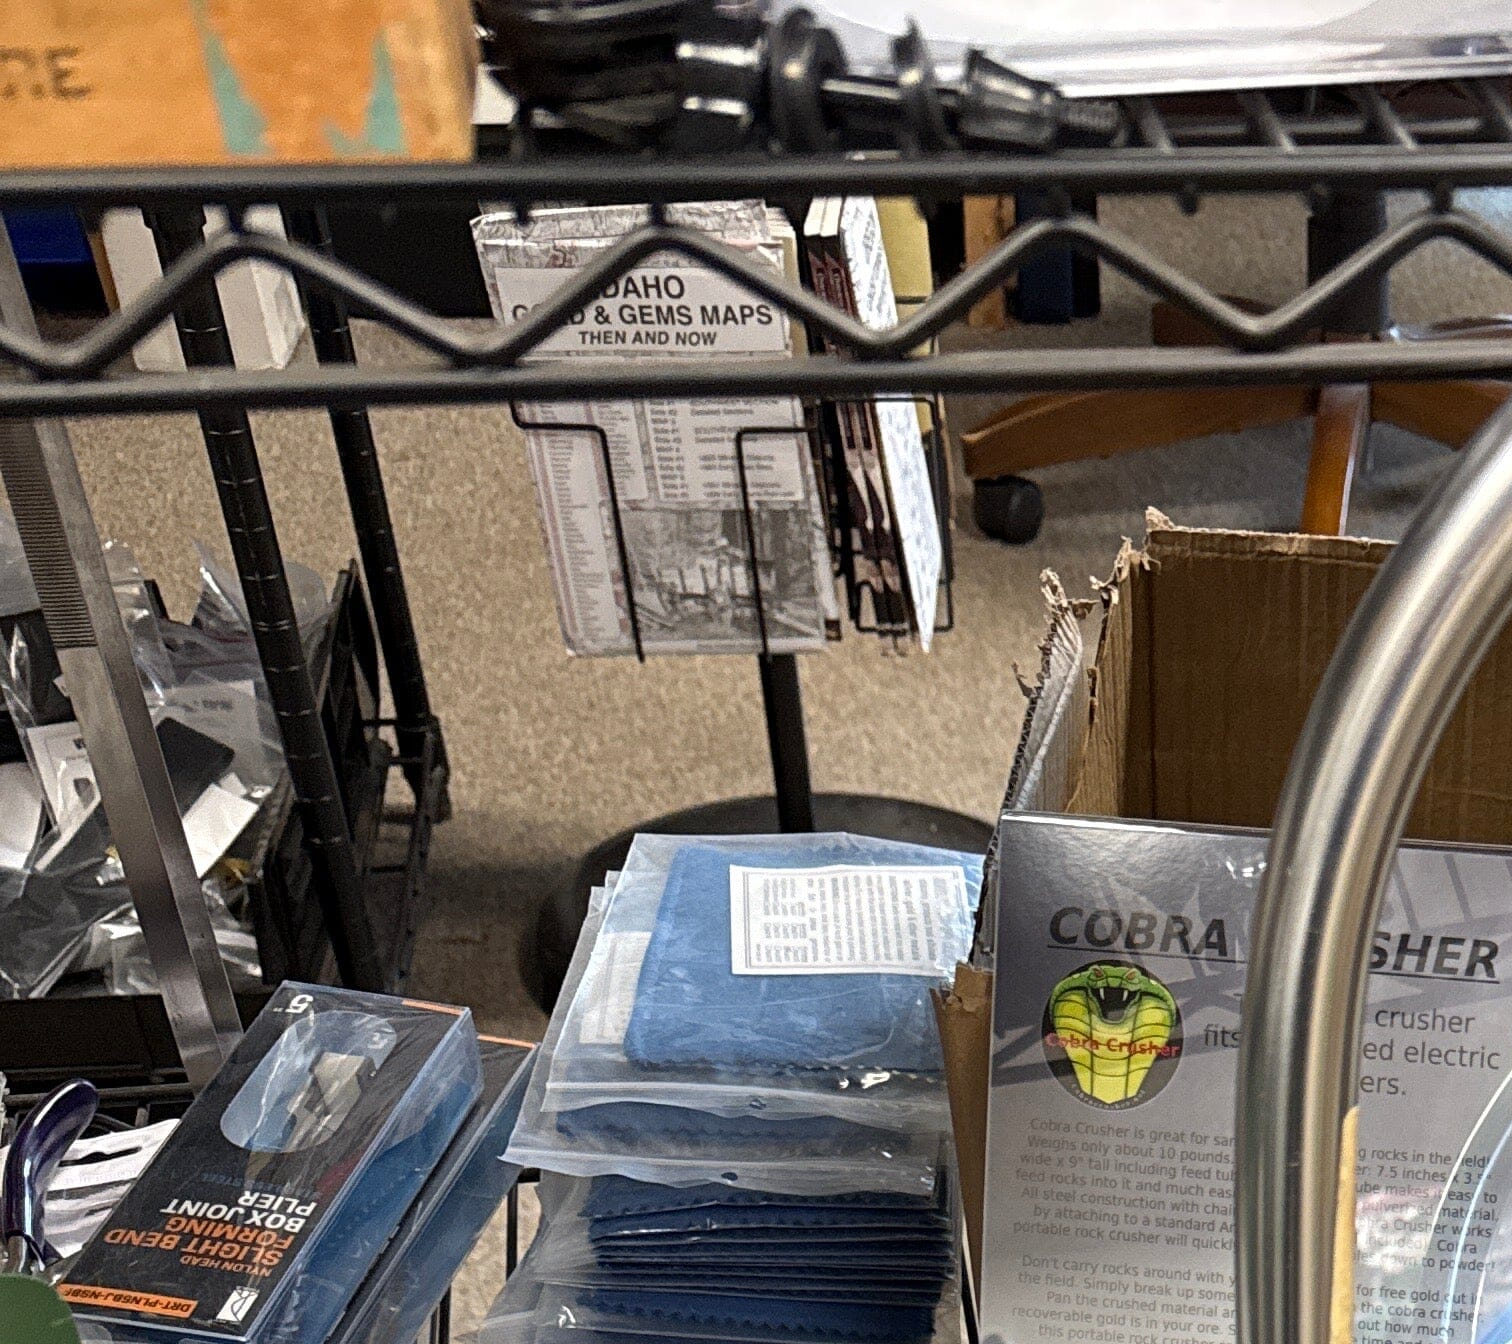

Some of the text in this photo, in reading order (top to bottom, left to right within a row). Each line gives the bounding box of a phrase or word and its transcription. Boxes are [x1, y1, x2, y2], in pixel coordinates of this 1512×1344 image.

[601, 275, 684, 299] DAHO
[595, 306, 611, 324] &
[619, 304, 692, 326] GEMS
[700, 304, 773, 325] MAPS
[579, 331, 717, 345] THEN AND NOW
[1049, 906, 1499, 979] COBRA SHER
[1374, 1008, 1475, 1033] crusher
[1107, 1038, 1180, 1057] Crusher
[1404, 1042, 1500, 1070] electric
[1075, 1121, 1130, 1138] Crusher
[1133, 1124, 1145, 1139] is
[1150, 1128, 1186, 1143] great
[1190, 1130, 1210, 1145] for
[1371, 1149, 1408, 1162] rocks
[1412, 1151, 1425, 1162] in
[1429, 1152, 1452, 1165] the
[160, 1199, 306, 1233] BOX JOINT
[238, 1190, 317, 1217] PLIER
[165, 1216, 295, 1251] FORMING
[103, 1228, 284, 1266] SLIGHT BEND
[180, 1255, 274, 1278] NYLON HEAD
[1062, 1259, 1099, 1274] carry
[1103, 1262, 1139, 1277] rocks
[1144, 1266, 1191, 1281] around
[1196, 1270, 1224, 1284] with
